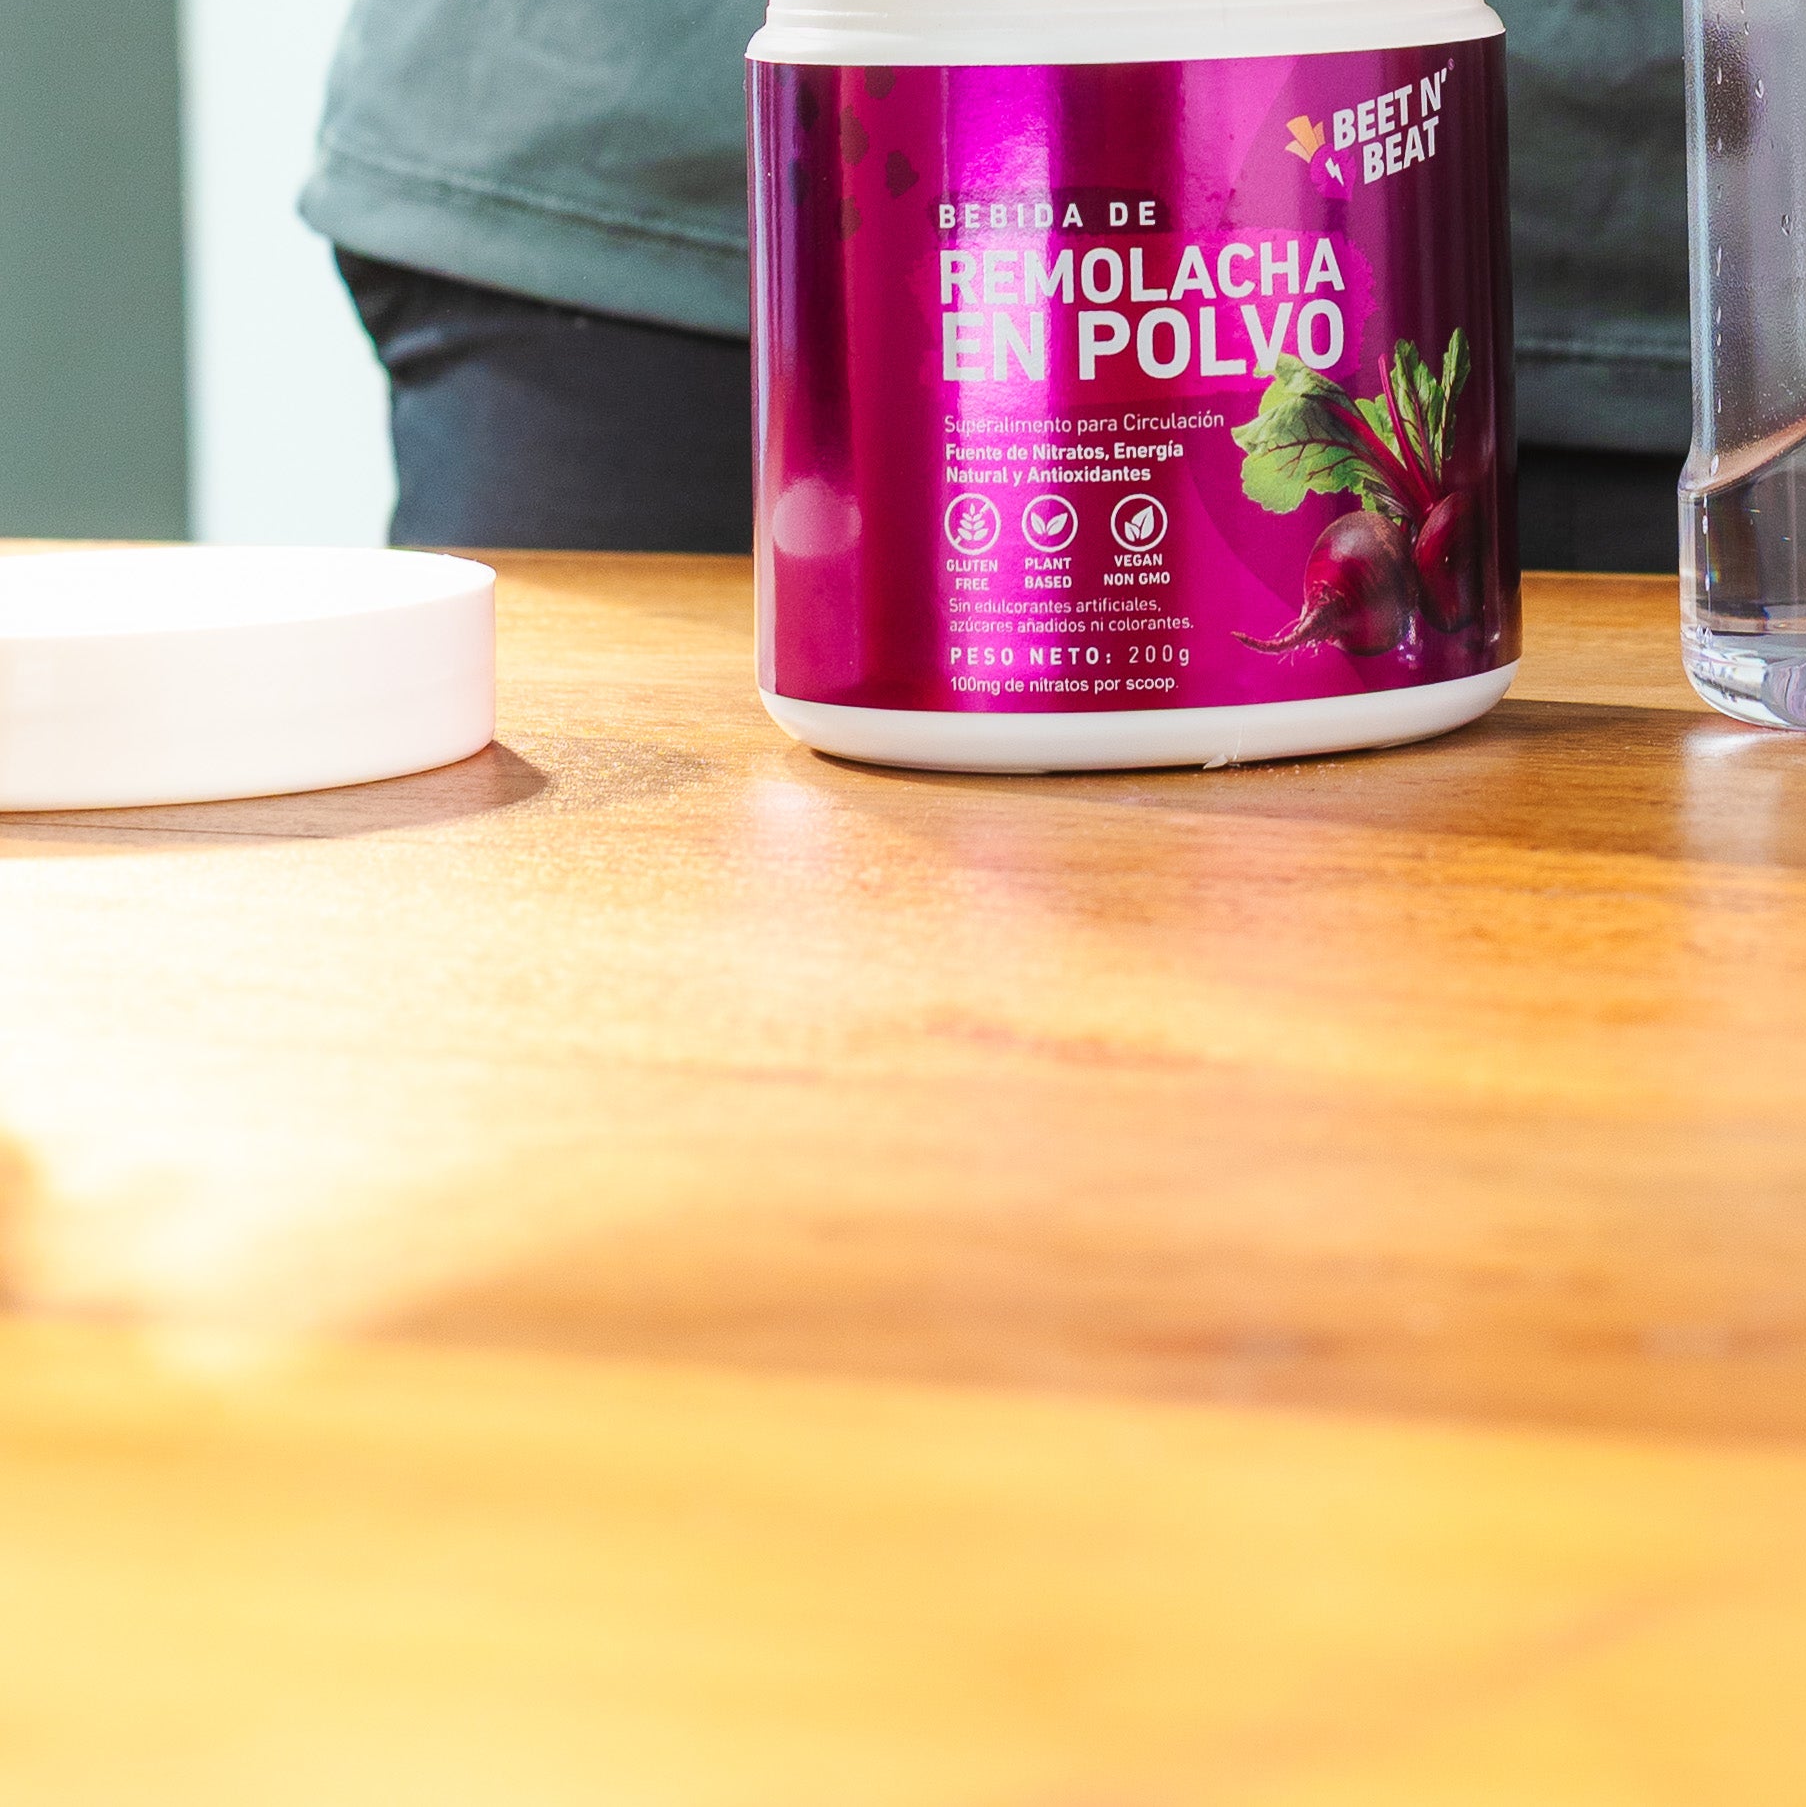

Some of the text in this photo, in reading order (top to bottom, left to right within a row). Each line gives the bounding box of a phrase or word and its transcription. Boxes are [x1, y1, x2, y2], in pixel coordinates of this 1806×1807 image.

[1333, 84, 1413, 151] BEET
[1363, 116, 1439, 184] BEAT
[938, 200, 1156, 229] BEBIDA DE
[939, 238, 1345, 305] REMOLACHA
[942, 299, 1345, 382] EN POLVO
[944, 410, 1225, 437] Superalimento para Circulación
[945, 440, 1184, 462] Fuente de Nitratos, Energía
[946, 466, 1151, 487] Natural y Antioxidantes
[946, 559, 998, 573] GLUTEN
[1025, 557, 1072, 571] PLANT
[1114, 554, 1163, 567] VEGAN
[955, 577, 990, 591] FREE
[1025, 575, 1072, 589] BASED
[1103, 571, 1171, 586] NON GMO
[949, 596, 1162, 614] Sin edulcorantes artificiales,
[949, 616, 1195, 633] azúcares añadidos ni colorantes.
[950, 645, 1191, 667] PESO NETO: 200g
[951, 676, 1001, 696] 100mg
[1004, 677, 1025, 693] de
[1029, 677, 1090, 692] nitratos
[1094, 678, 1121, 695] por
